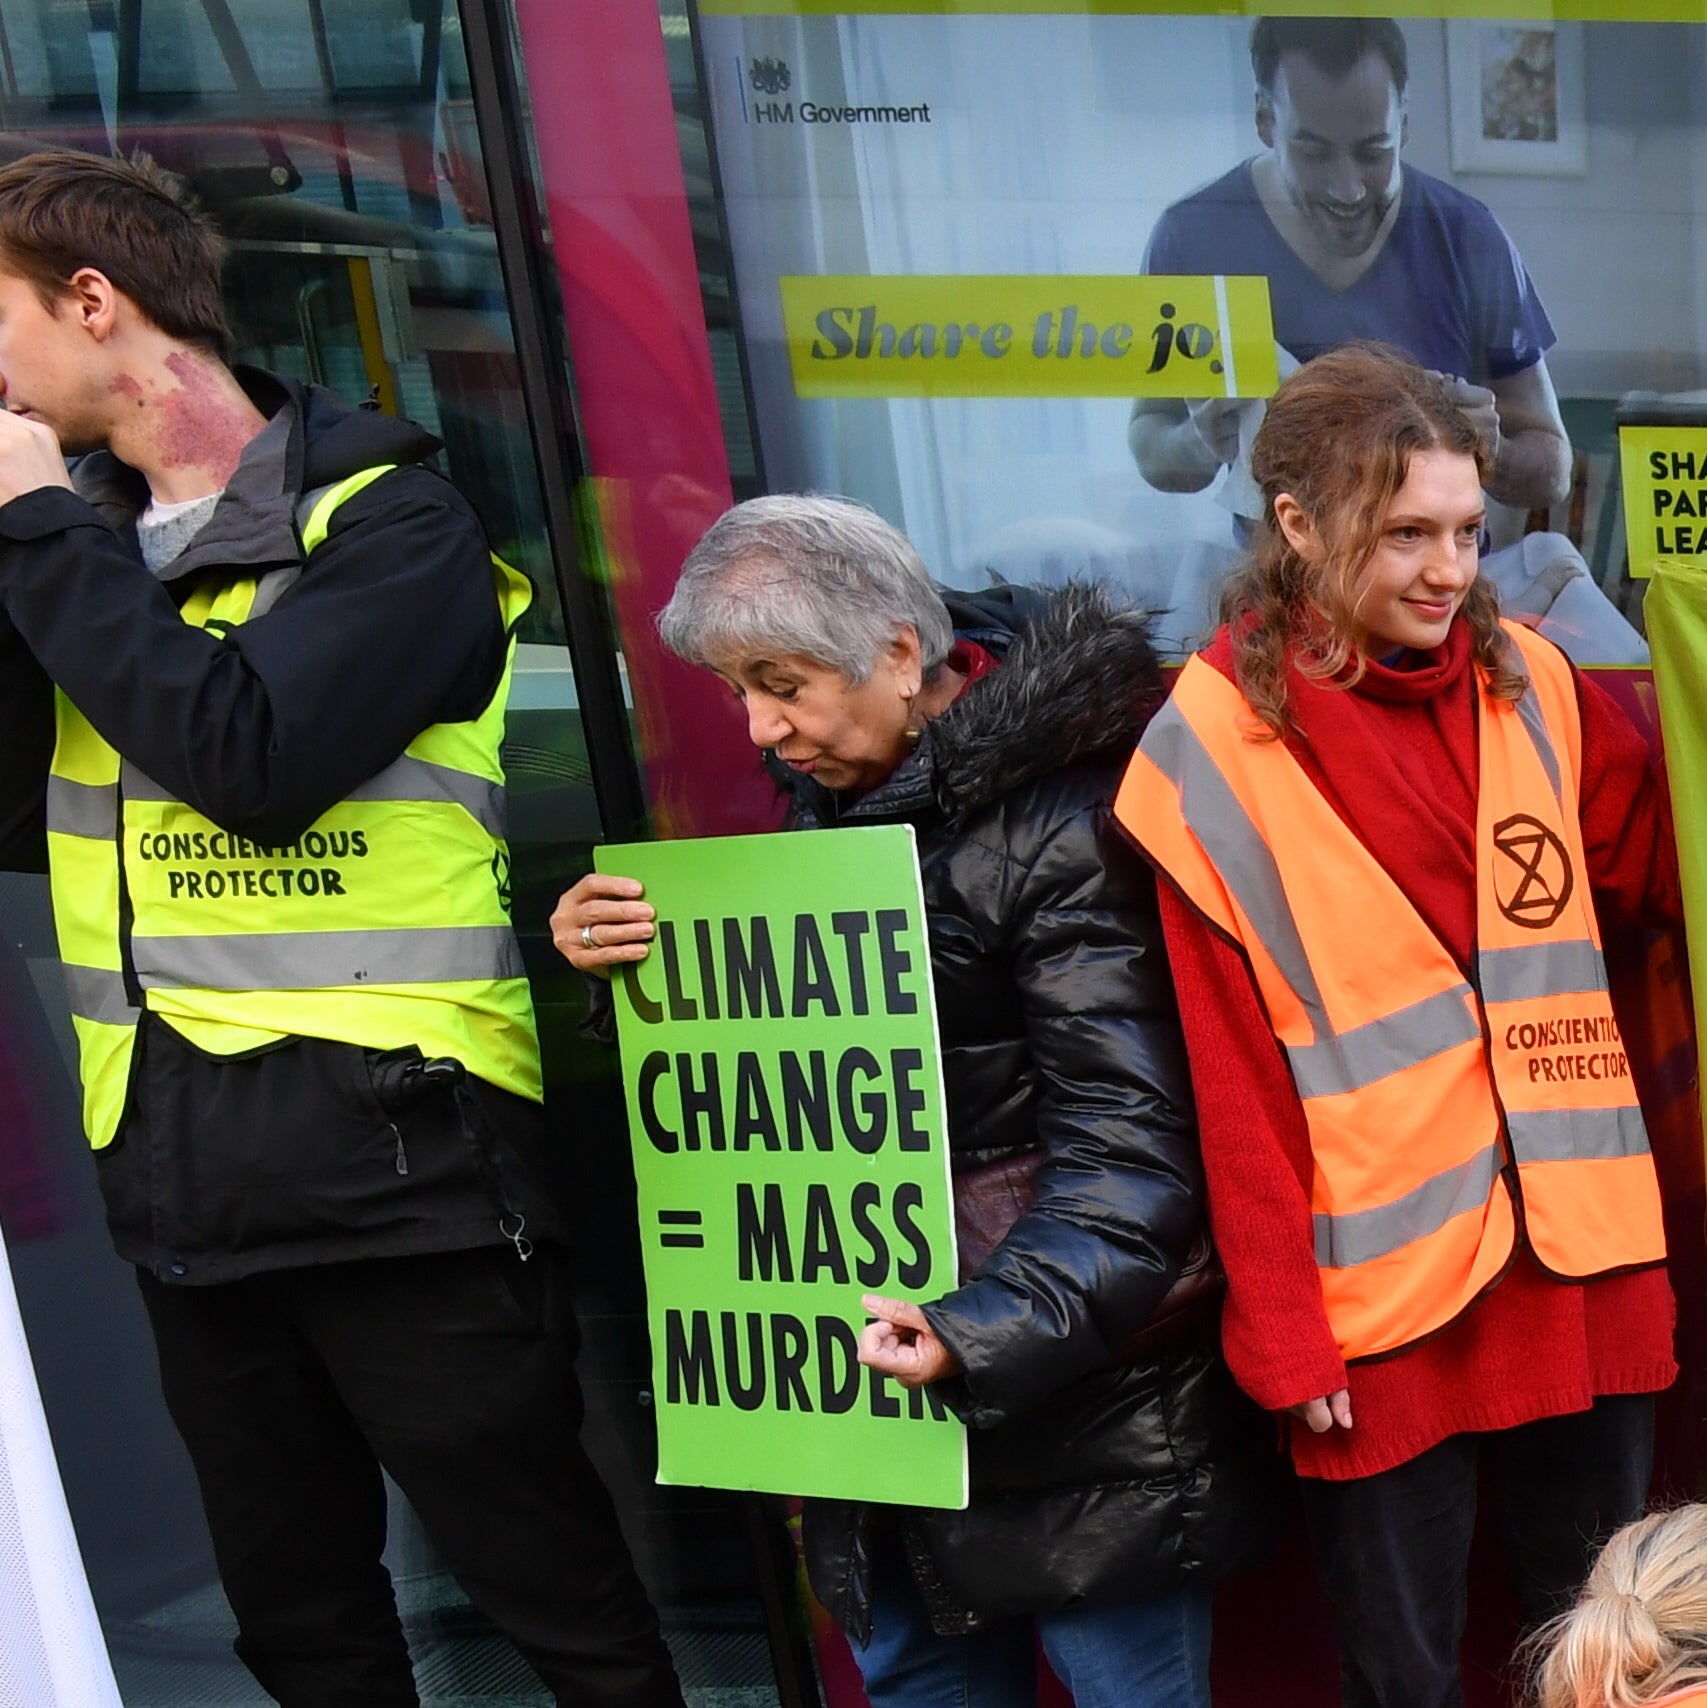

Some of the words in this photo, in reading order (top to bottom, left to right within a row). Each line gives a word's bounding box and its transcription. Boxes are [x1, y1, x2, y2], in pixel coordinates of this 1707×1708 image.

[755, 103, 794, 123] HM
[799, 102, 931, 124] Government
[811, 305, 1013, 361] Share
[1031, 305, 1133, 361] the
[1146, 302, 1224, 376] jo
[167, 868, 348, 899] PROTECTOR
[624, 909, 918, 1025] CLIMATE
[637, 1047, 932, 1155] CHANGE
[1528, 1052, 1629, 1083] PROTECTOR
[736, 1182, 933, 1289] MASS
